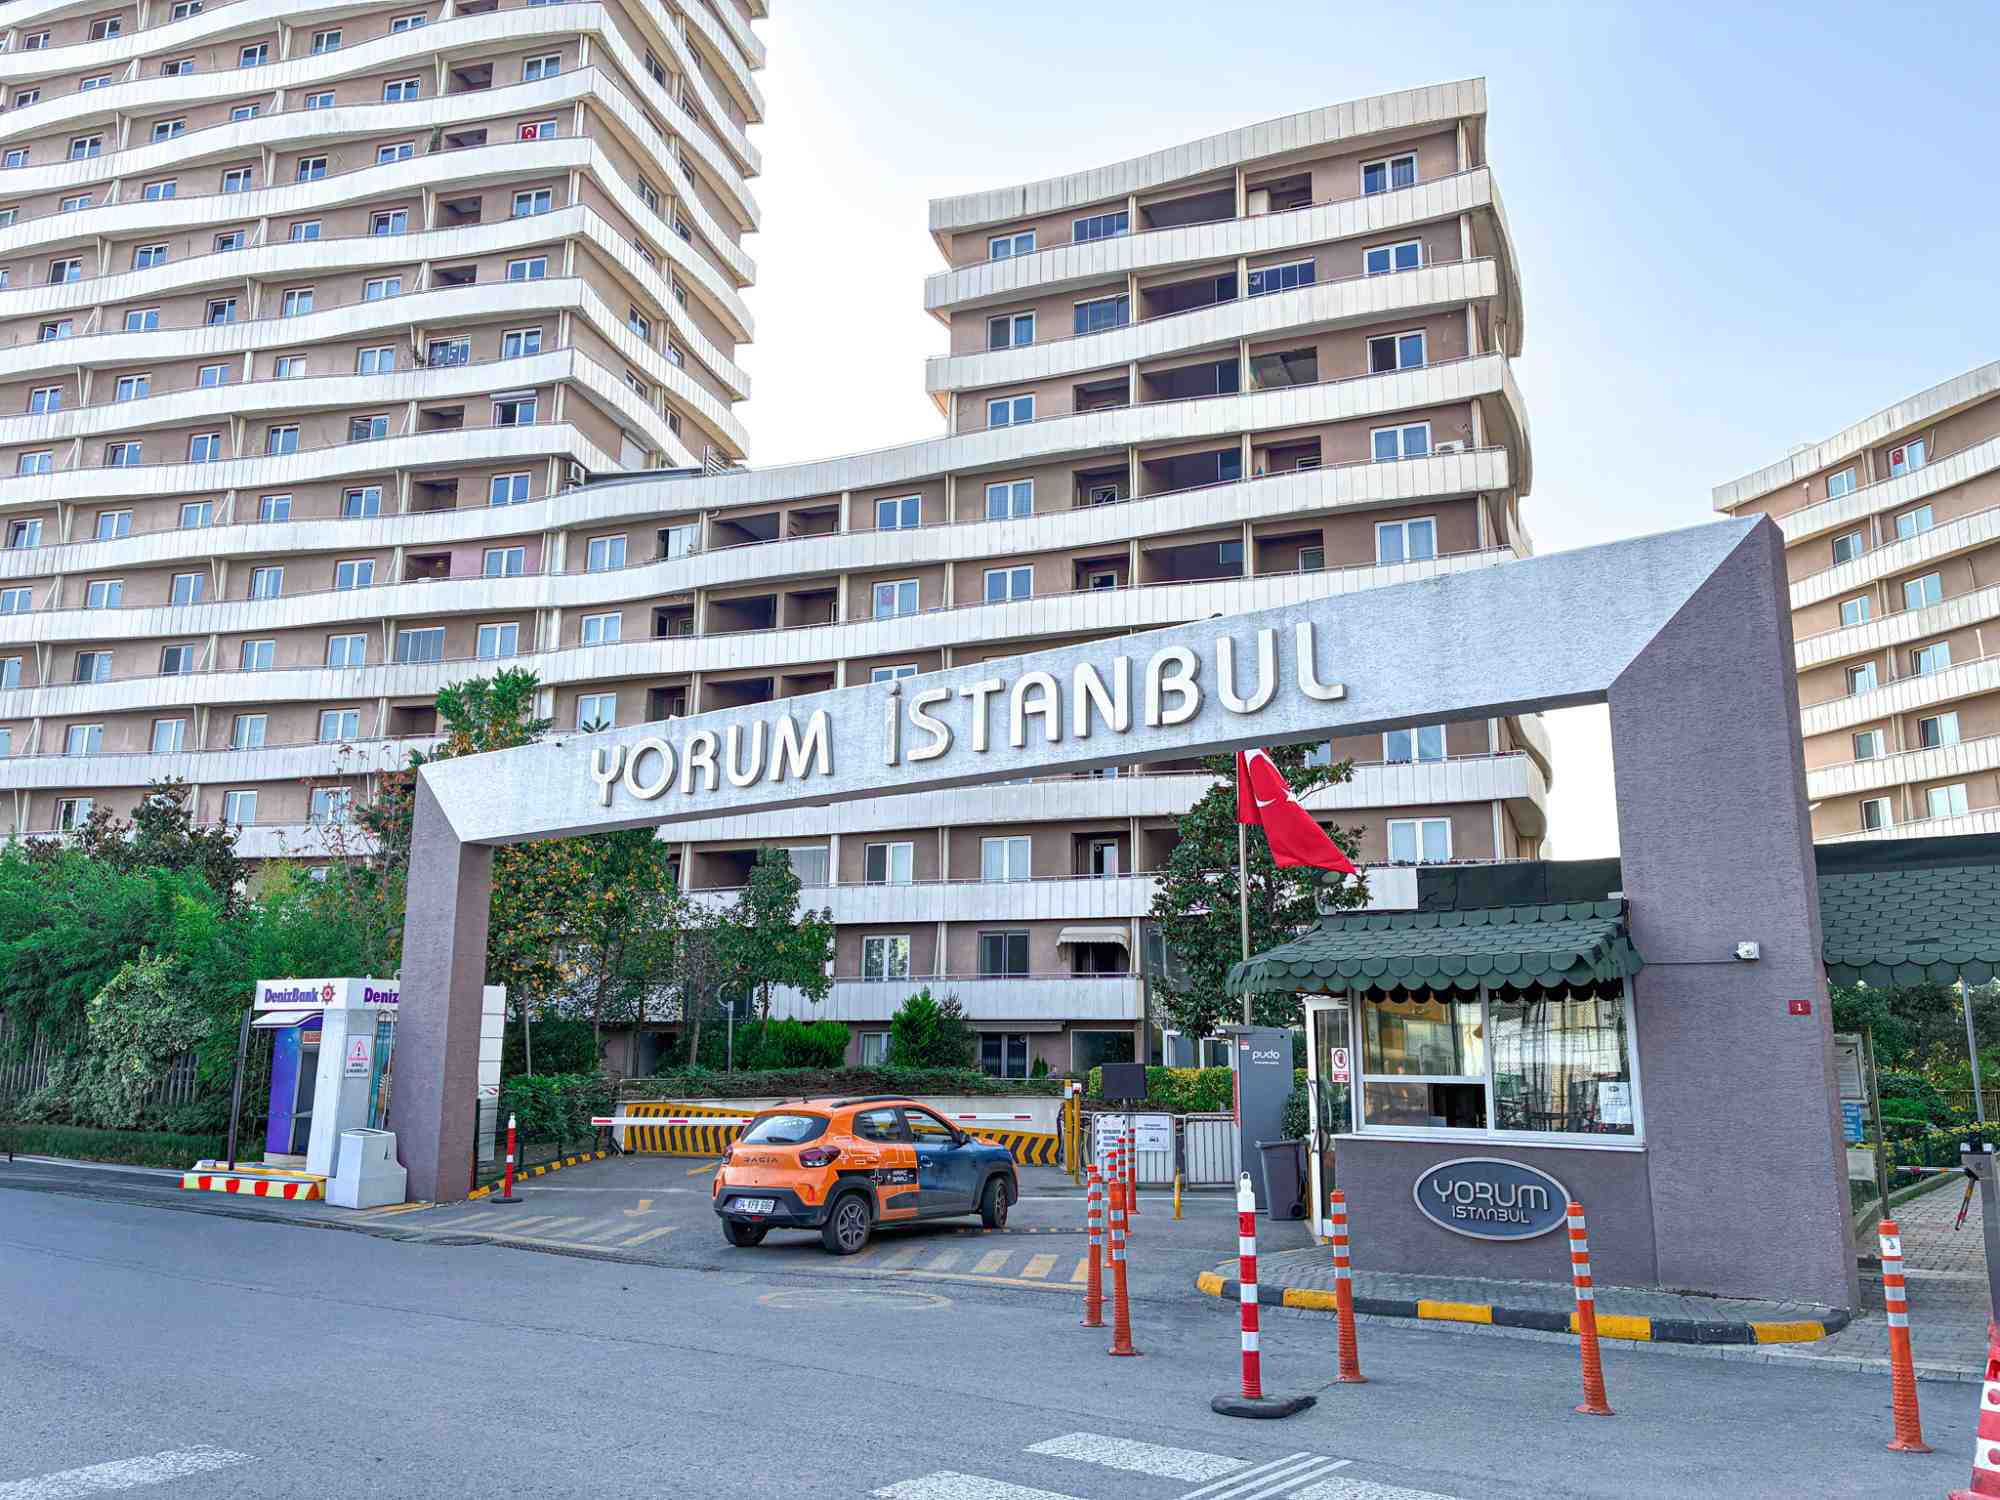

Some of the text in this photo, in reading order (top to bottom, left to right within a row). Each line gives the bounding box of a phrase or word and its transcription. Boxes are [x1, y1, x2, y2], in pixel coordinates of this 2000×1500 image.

[591, 621, 1347, 808] YORUM İSTANBUL
[264, 986, 319, 1003] DenizBank
[1252, 1049, 1280, 1060] pudo
[1433, 1179, 1549, 1210] YORUM
